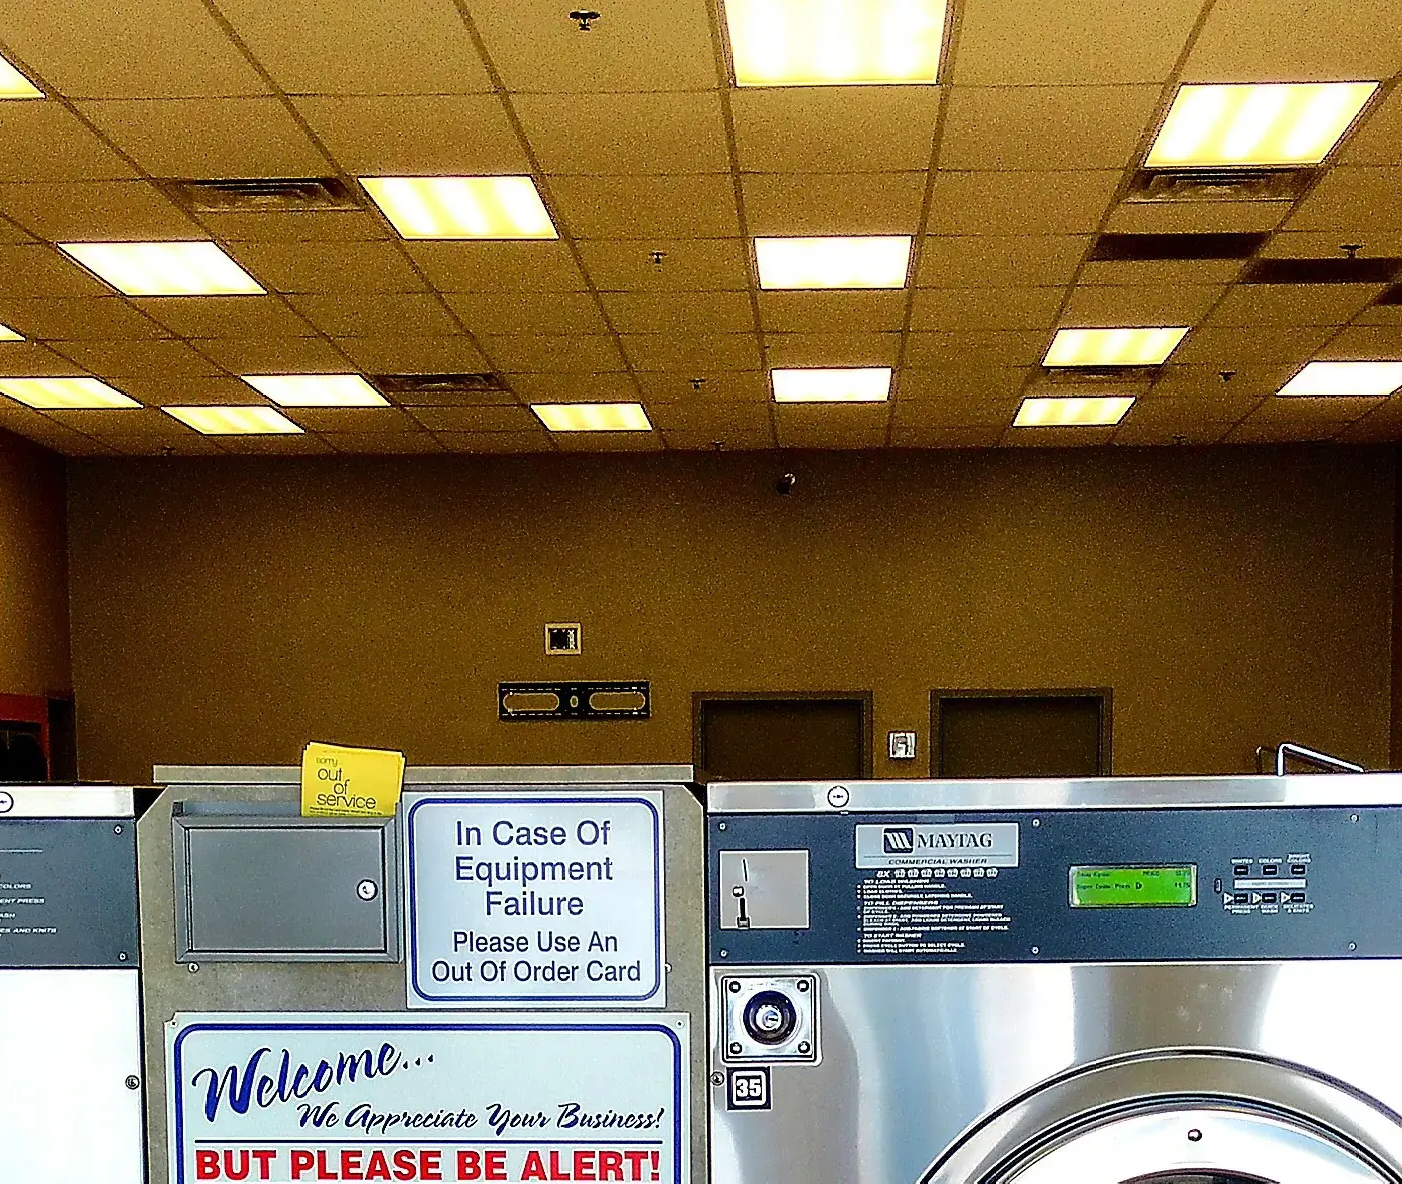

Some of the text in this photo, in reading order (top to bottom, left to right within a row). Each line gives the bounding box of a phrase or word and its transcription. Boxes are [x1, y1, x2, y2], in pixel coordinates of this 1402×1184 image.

[317, 768, 343, 782] out
[333, 779, 350, 795] of
[317, 794, 377, 809] service
[457, 820, 610, 845] In Case Of
[917, 834, 992, 848] MAYTAG
[456, 856, 612, 887] Equipment
[487, 891, 583, 915] Failure
[454, 931, 617, 952] Please Use An
[432, 960, 640, 981] Out Of Order Card
[192, 1043, 434, 1123] Welcome...
[736, 1078, 762, 1097] 35
[297, 1102, 665, 1136] We Appreciate Your Business!
[196, 1150, 659, 1181] BUT PLEASE BE ALERT!
